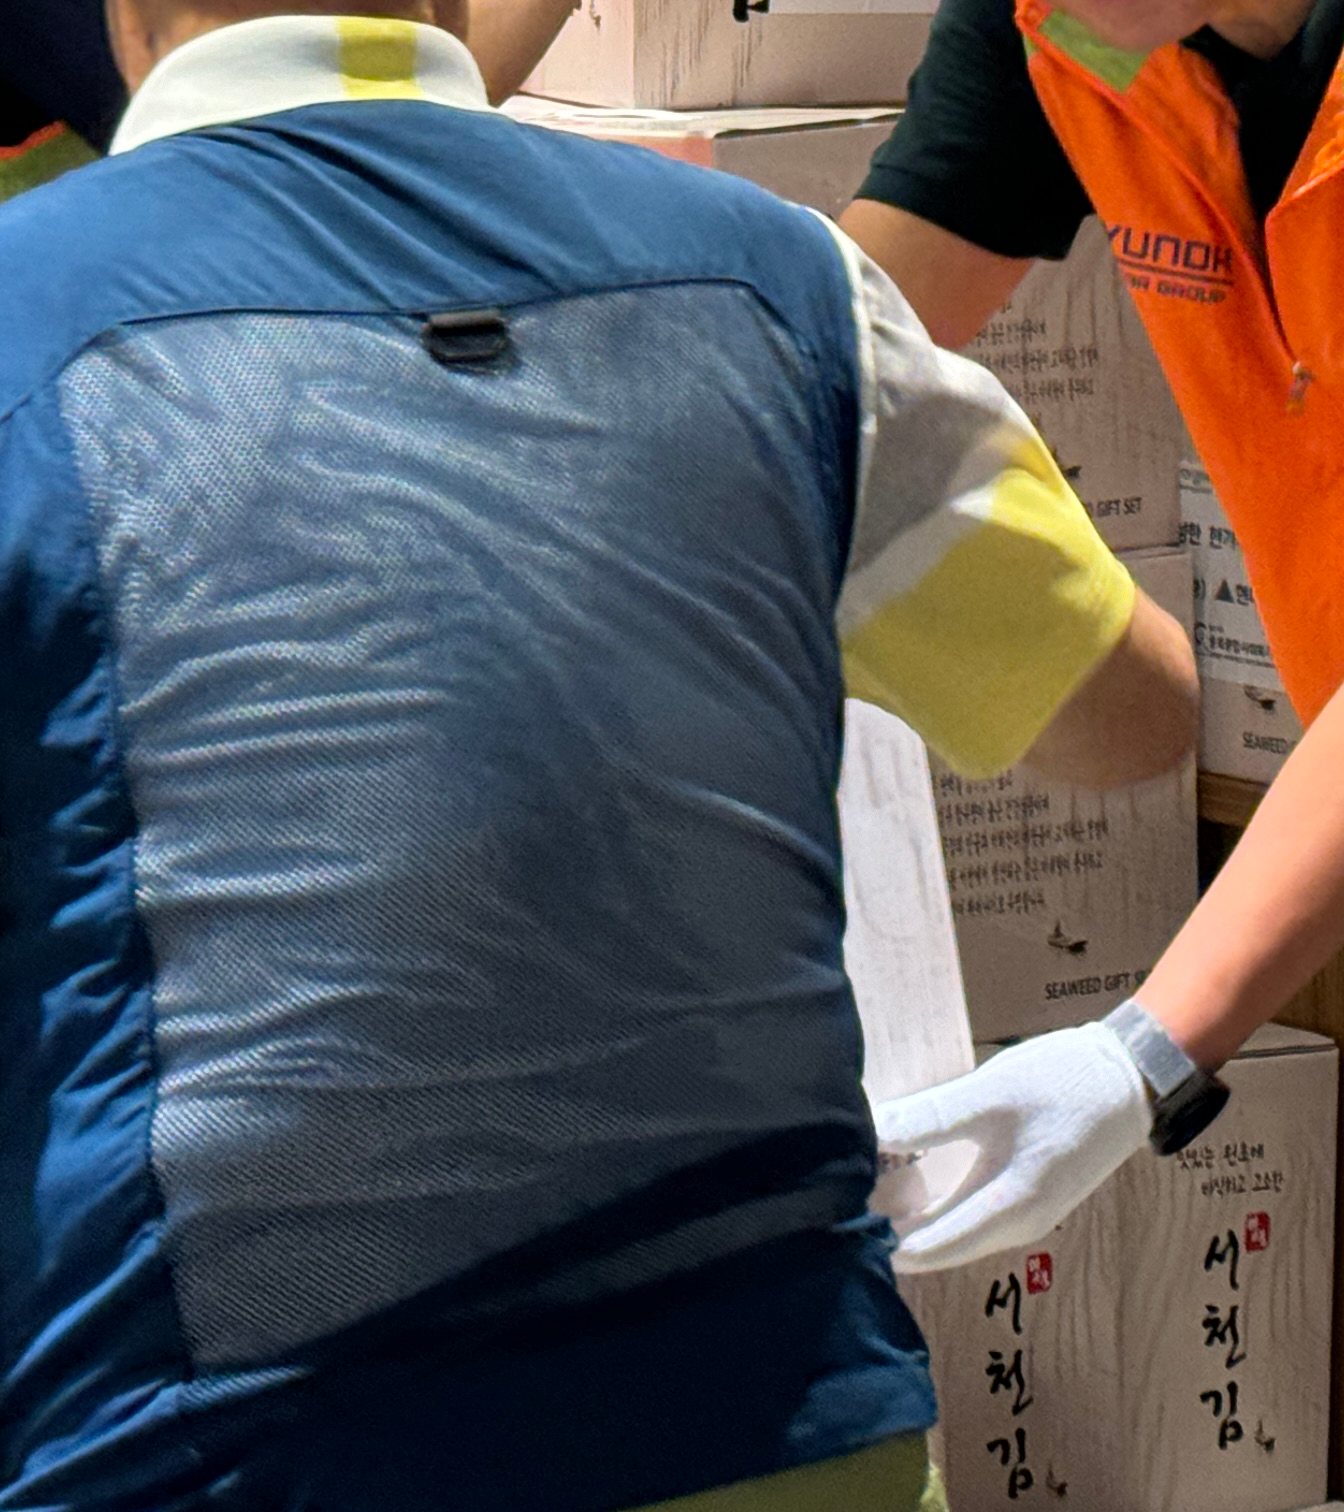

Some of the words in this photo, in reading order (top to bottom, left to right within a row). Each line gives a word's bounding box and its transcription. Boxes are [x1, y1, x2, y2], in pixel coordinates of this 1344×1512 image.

[1044, 974, 1102, 1000] SEAWEED
[1105, 973, 1131, 992] GIFT
[985, 1272, 1033, 1499] 서천김
[1201, 1229, 1246, 1450] 서천김
